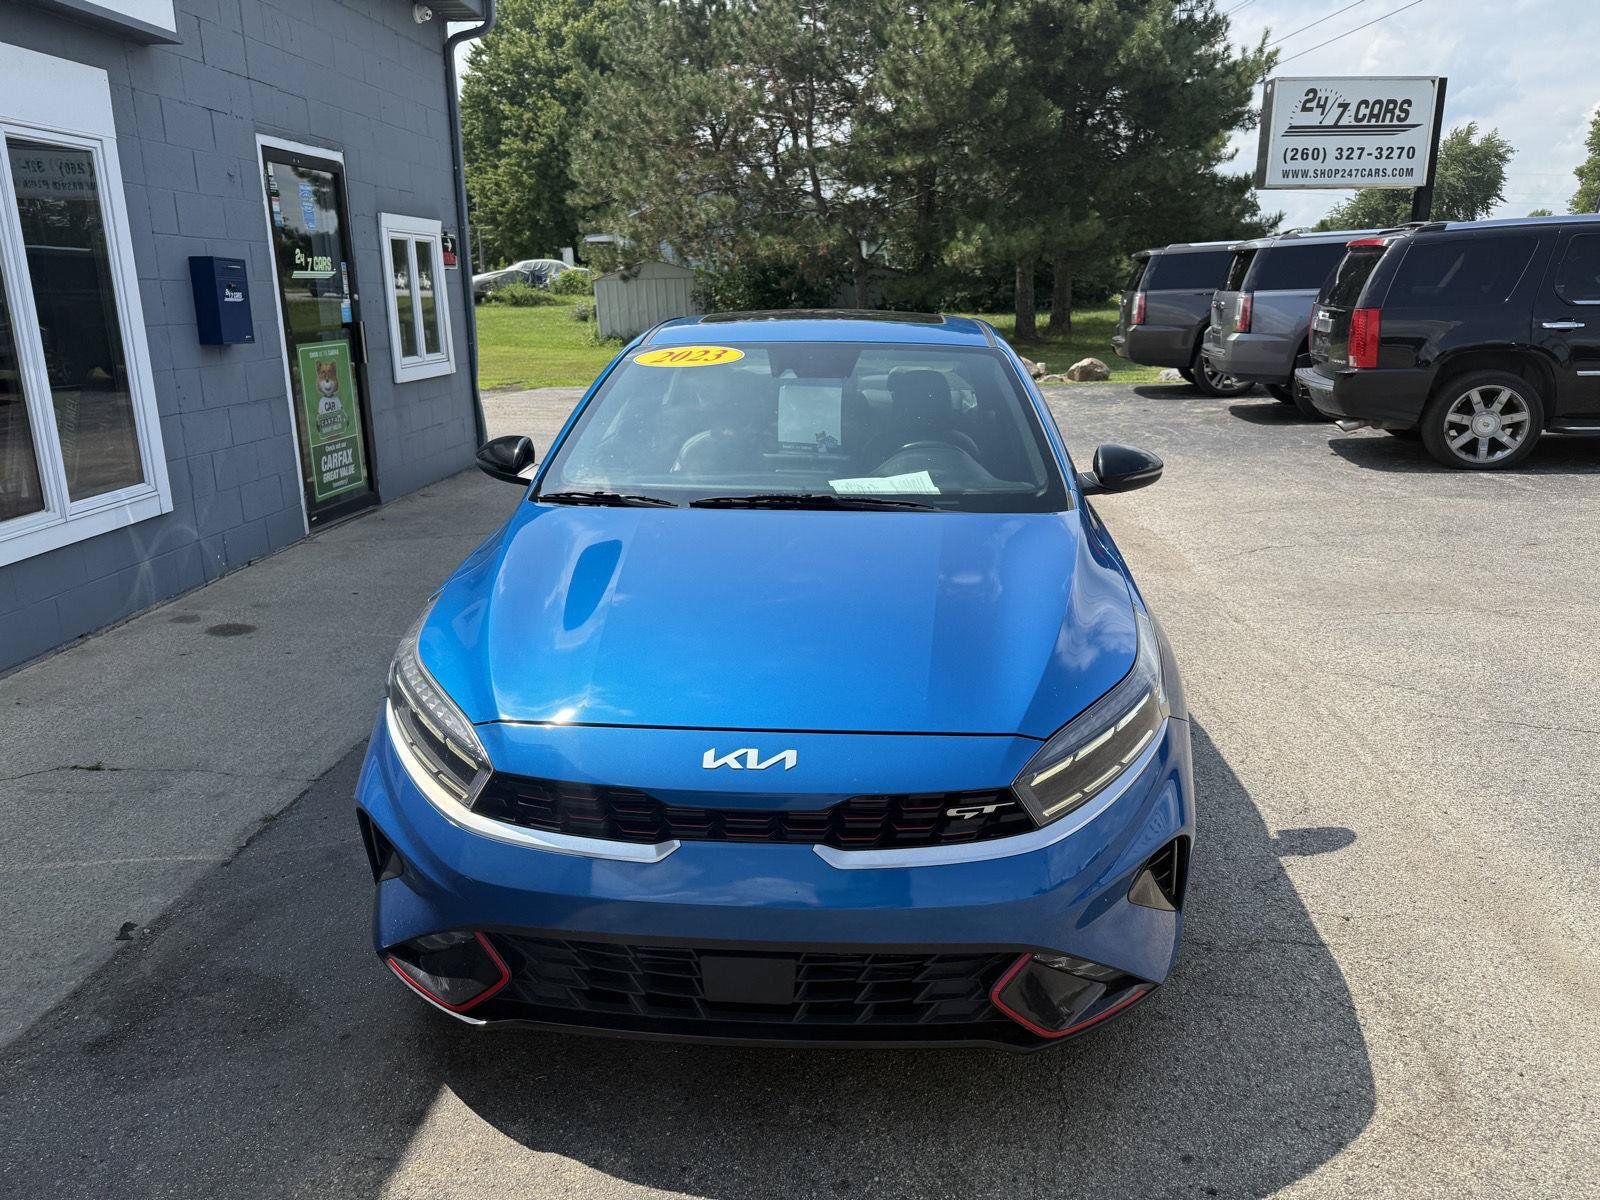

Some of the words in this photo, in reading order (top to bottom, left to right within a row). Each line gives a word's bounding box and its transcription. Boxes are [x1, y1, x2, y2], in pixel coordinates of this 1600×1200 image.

[1353, 99, 1413, 123] CARS
[1283, 147, 1327, 164] (260)
[1335, 146, 1416, 161] 327-3270
[1282, 168, 1414, 179] WWW.SHOP247CARS.COM
[313, 256, 332, 271] CARS
[649, 349, 728, 364] 2023
[324, 402, 336, 412] CAR
[321, 448, 353, 472] CARFAX
[323, 469, 339, 484] GREAT
[339, 464, 356, 478] VALUE
[702, 748, 798, 771] KIA
[946, 802, 1016, 820] GT
